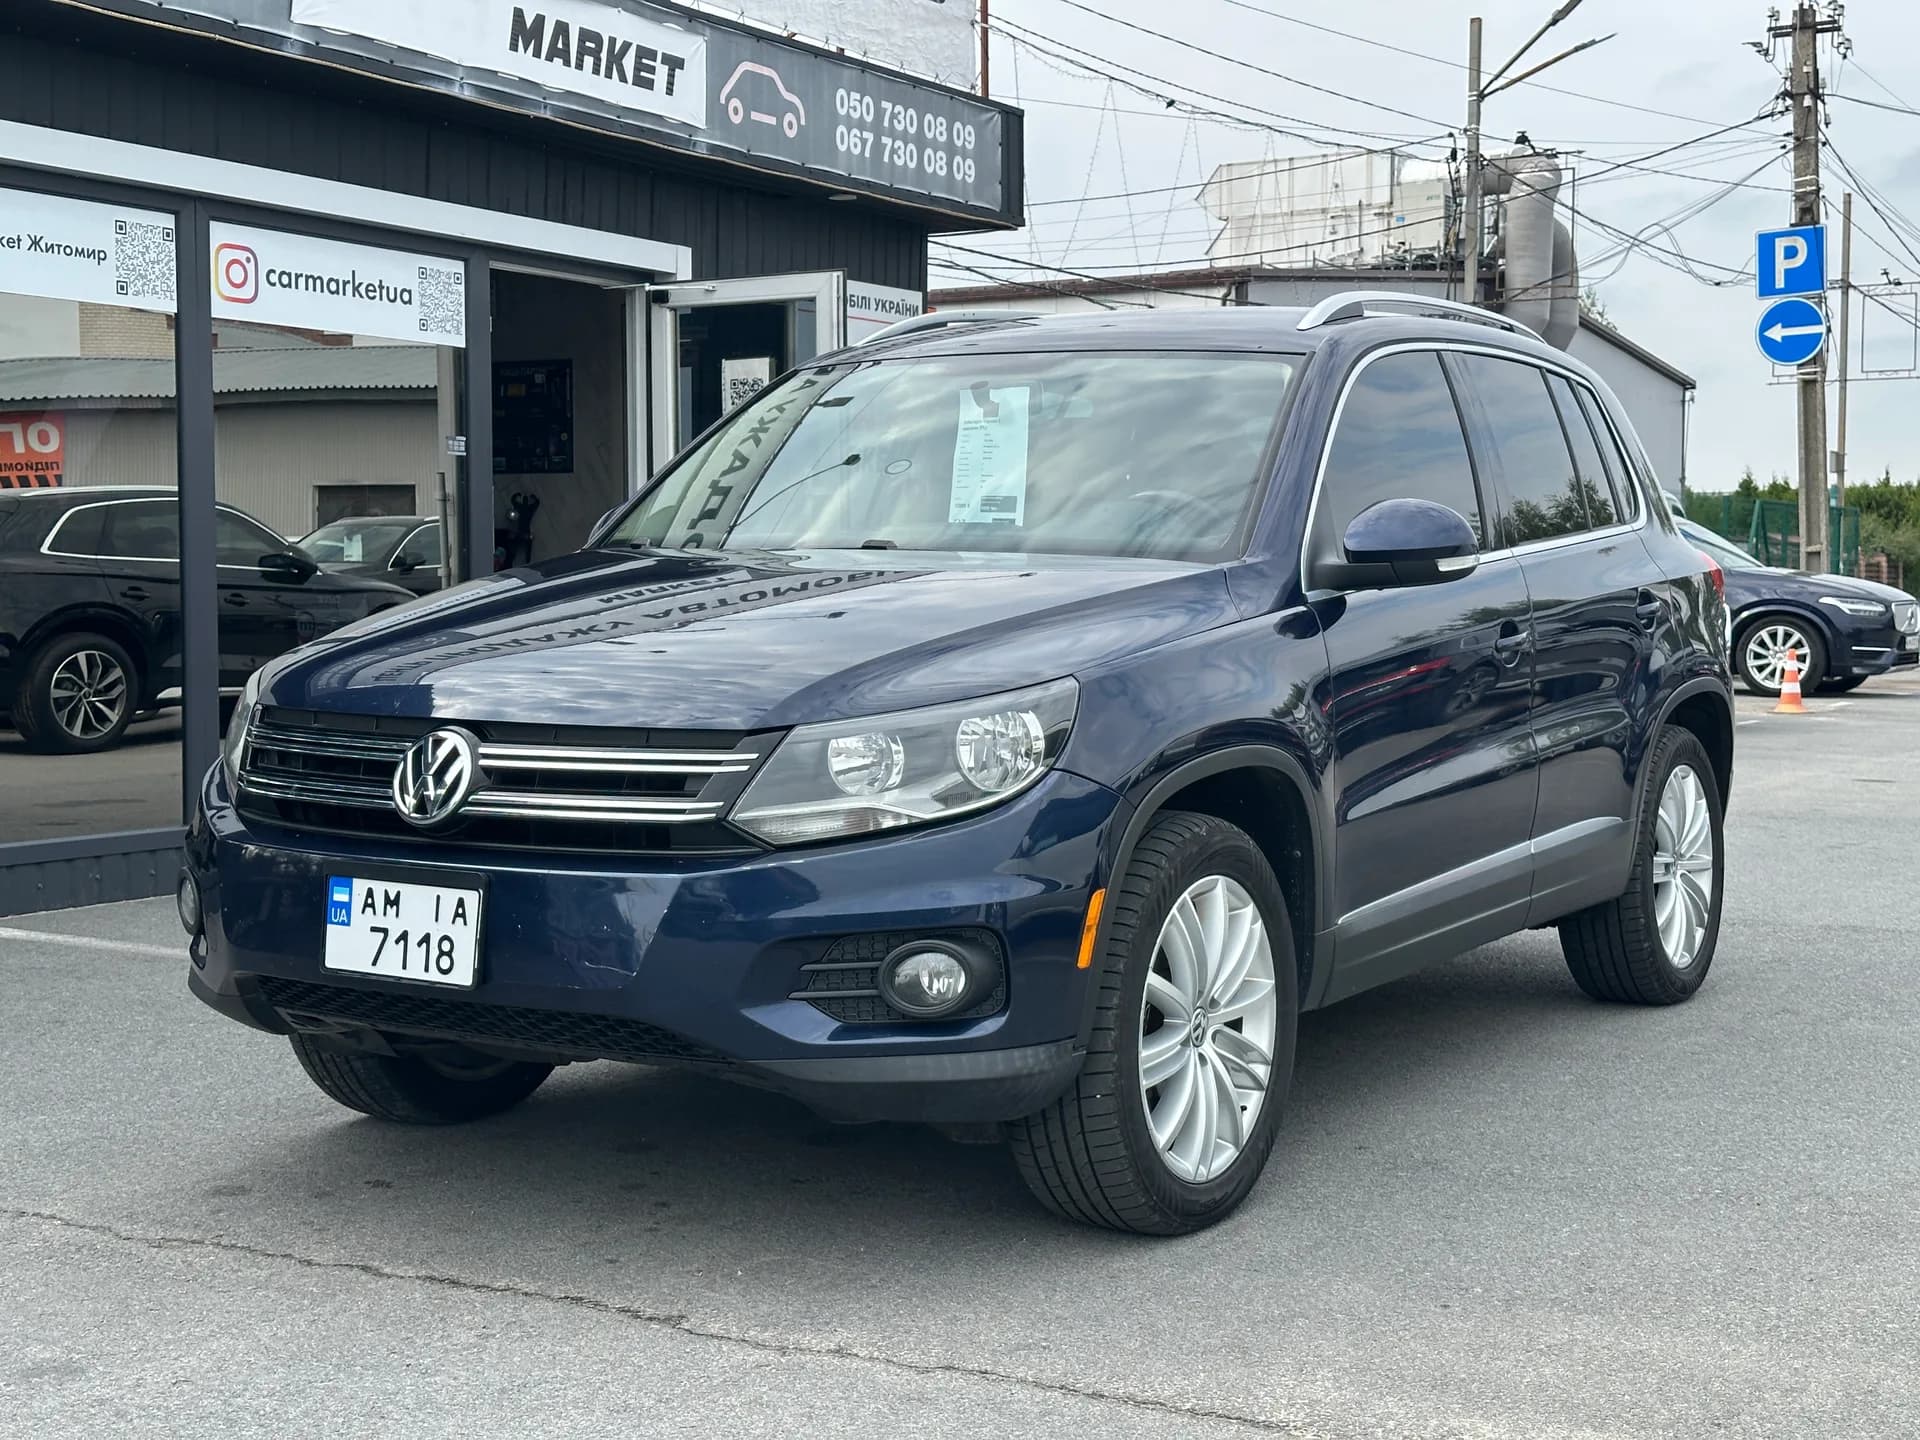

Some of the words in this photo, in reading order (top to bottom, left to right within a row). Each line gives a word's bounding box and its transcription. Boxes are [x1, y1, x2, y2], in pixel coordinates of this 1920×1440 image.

[509, 7, 686, 97] MARKET
[835, 88, 875, 123] 050
[881, 100, 918, 135] 730
[923, 113, 948, 142] 08
[952, 121, 976, 150] 09
[835, 125, 875, 158] 067
[881, 136, 918, 169] 730
[923, 148, 948, 176] 08
[952, 155, 976, 183] 09
[26, 233, 108, 266] Житомир
[1774, 235, 1808, 289] P
[265, 268, 413, 306] carmarketua
[846, 293, 871, 311] БІЛІ
[873, 297, 920, 318] УКРАЇНИ
[331, 907, 348, 924] UA
[361, 886, 402, 919] AM
[434, 893, 468, 927] IA
[369, 925, 455, 976] 7118
